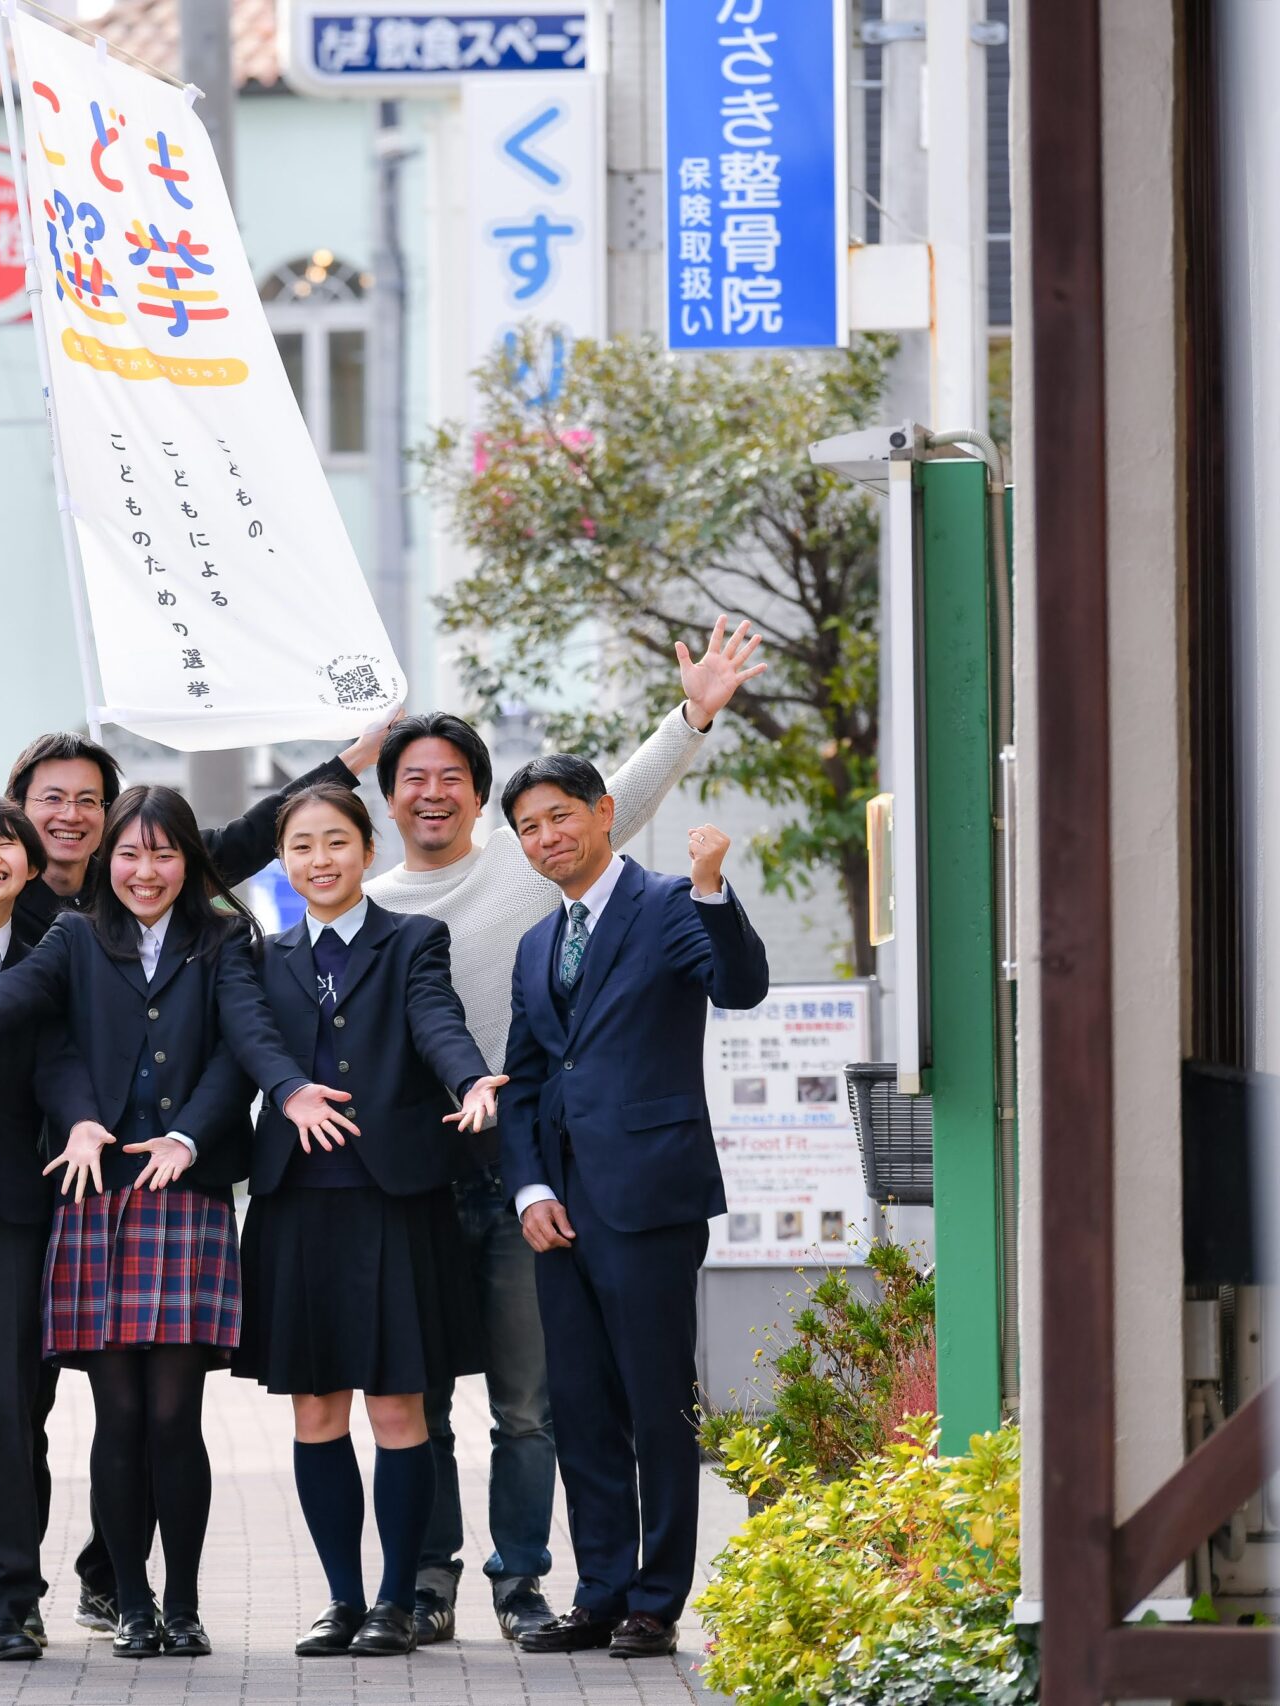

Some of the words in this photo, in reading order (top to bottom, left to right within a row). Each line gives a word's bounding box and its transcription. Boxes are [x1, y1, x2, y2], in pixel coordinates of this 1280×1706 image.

[32, 80, 194, 210] こども
[679, 157, 714, 336] 保険取扱い
[161, 441, 229, 607] こどもによる
